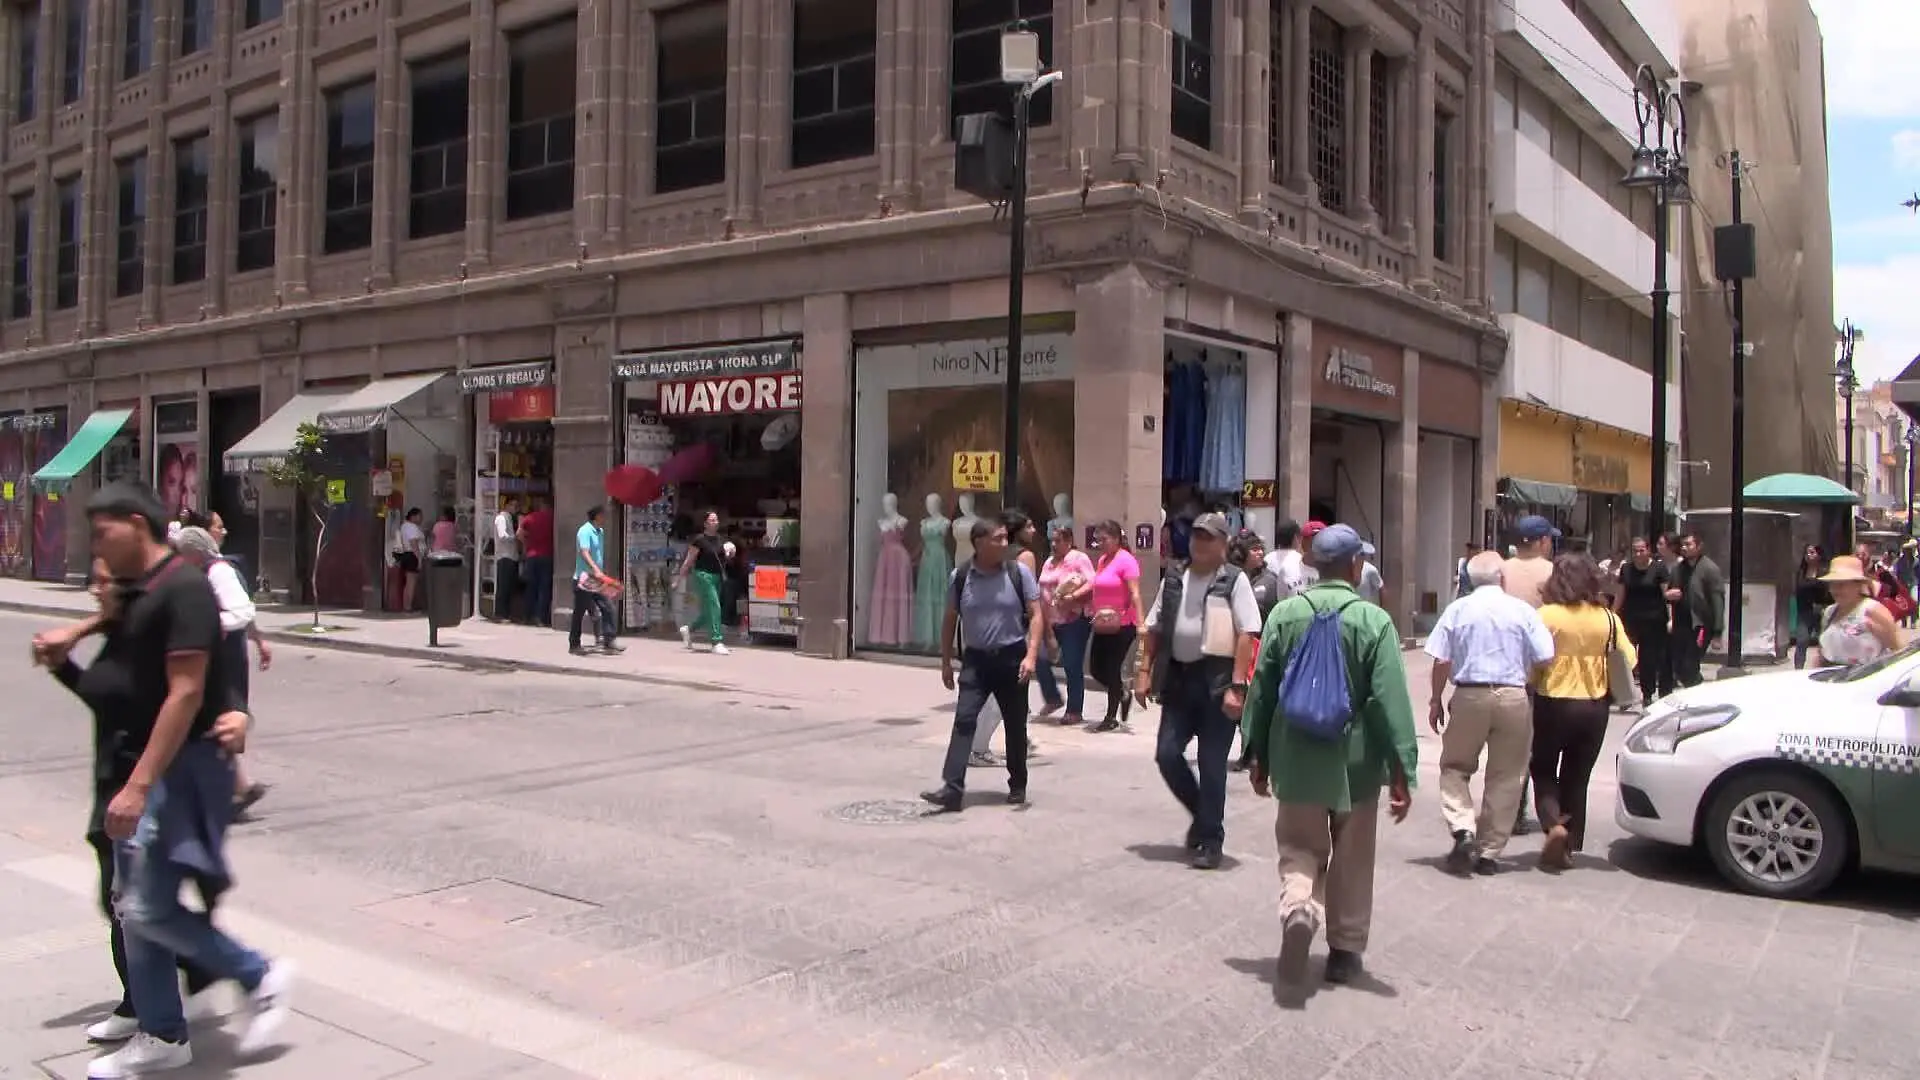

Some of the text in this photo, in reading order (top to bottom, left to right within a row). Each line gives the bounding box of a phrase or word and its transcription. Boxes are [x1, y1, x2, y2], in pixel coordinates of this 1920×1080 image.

[616, 363, 647, 377] ZONA
[650, 358, 714, 375] MAYORISTA
[761, 352, 783, 367] SLP
[933, 356, 970, 371] Nina
[661, 376, 801, 414] MAYORE
[959, 455, 968, 474] 2
[989, 453, 997, 474] 1
[1243, 482, 1253, 498] 2
[1777, 732, 1812, 746] ZONA
